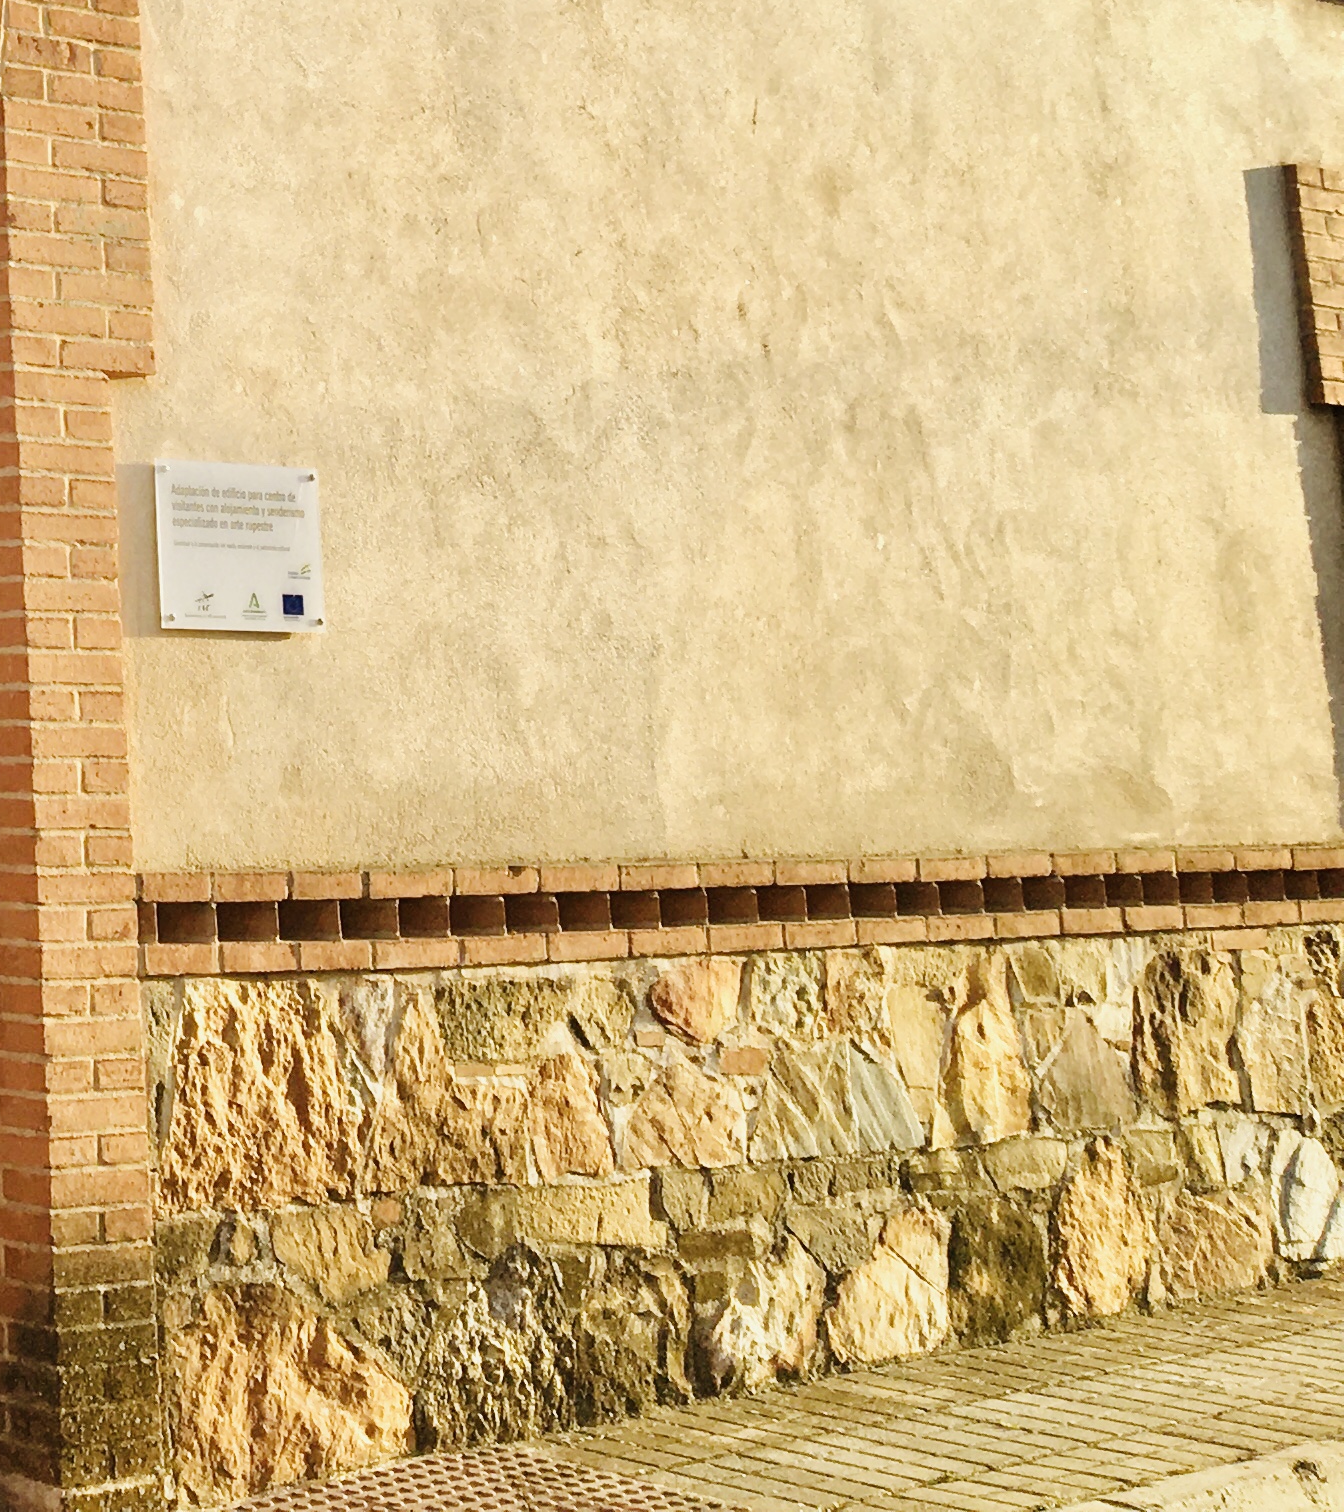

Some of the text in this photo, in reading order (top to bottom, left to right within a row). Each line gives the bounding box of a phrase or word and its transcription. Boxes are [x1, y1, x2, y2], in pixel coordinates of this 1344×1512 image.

[211, 487, 220, 497] de
[247, 490, 263, 502] para
[287, 491, 296, 502] de
[205, 504, 219, 513] con
[219, 520, 229, 529] en
[230, 521, 244, 531] arte
